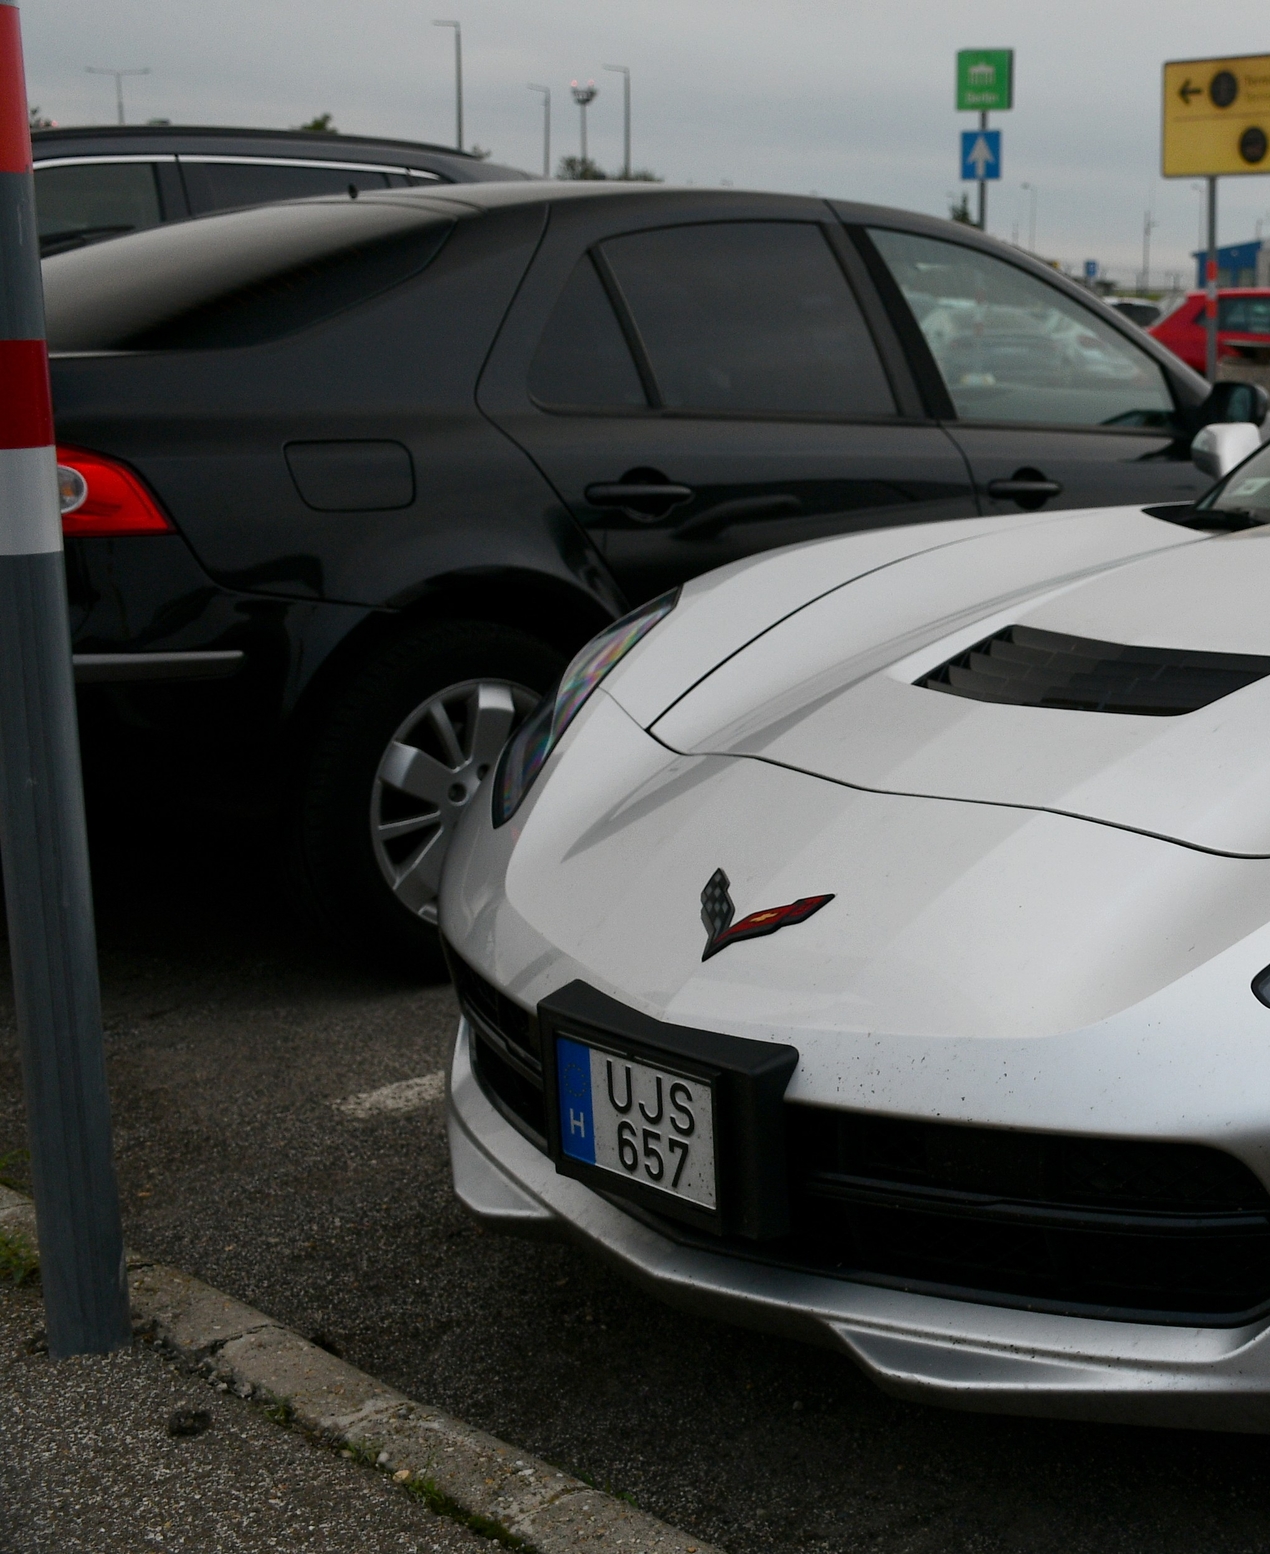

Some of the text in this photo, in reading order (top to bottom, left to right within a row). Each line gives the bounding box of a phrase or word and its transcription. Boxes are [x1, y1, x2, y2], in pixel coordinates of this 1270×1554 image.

[569, 1108, 585, 1138] H
[606, 1058, 696, 1136] UJS
[617, 1120, 689, 1188] 657
